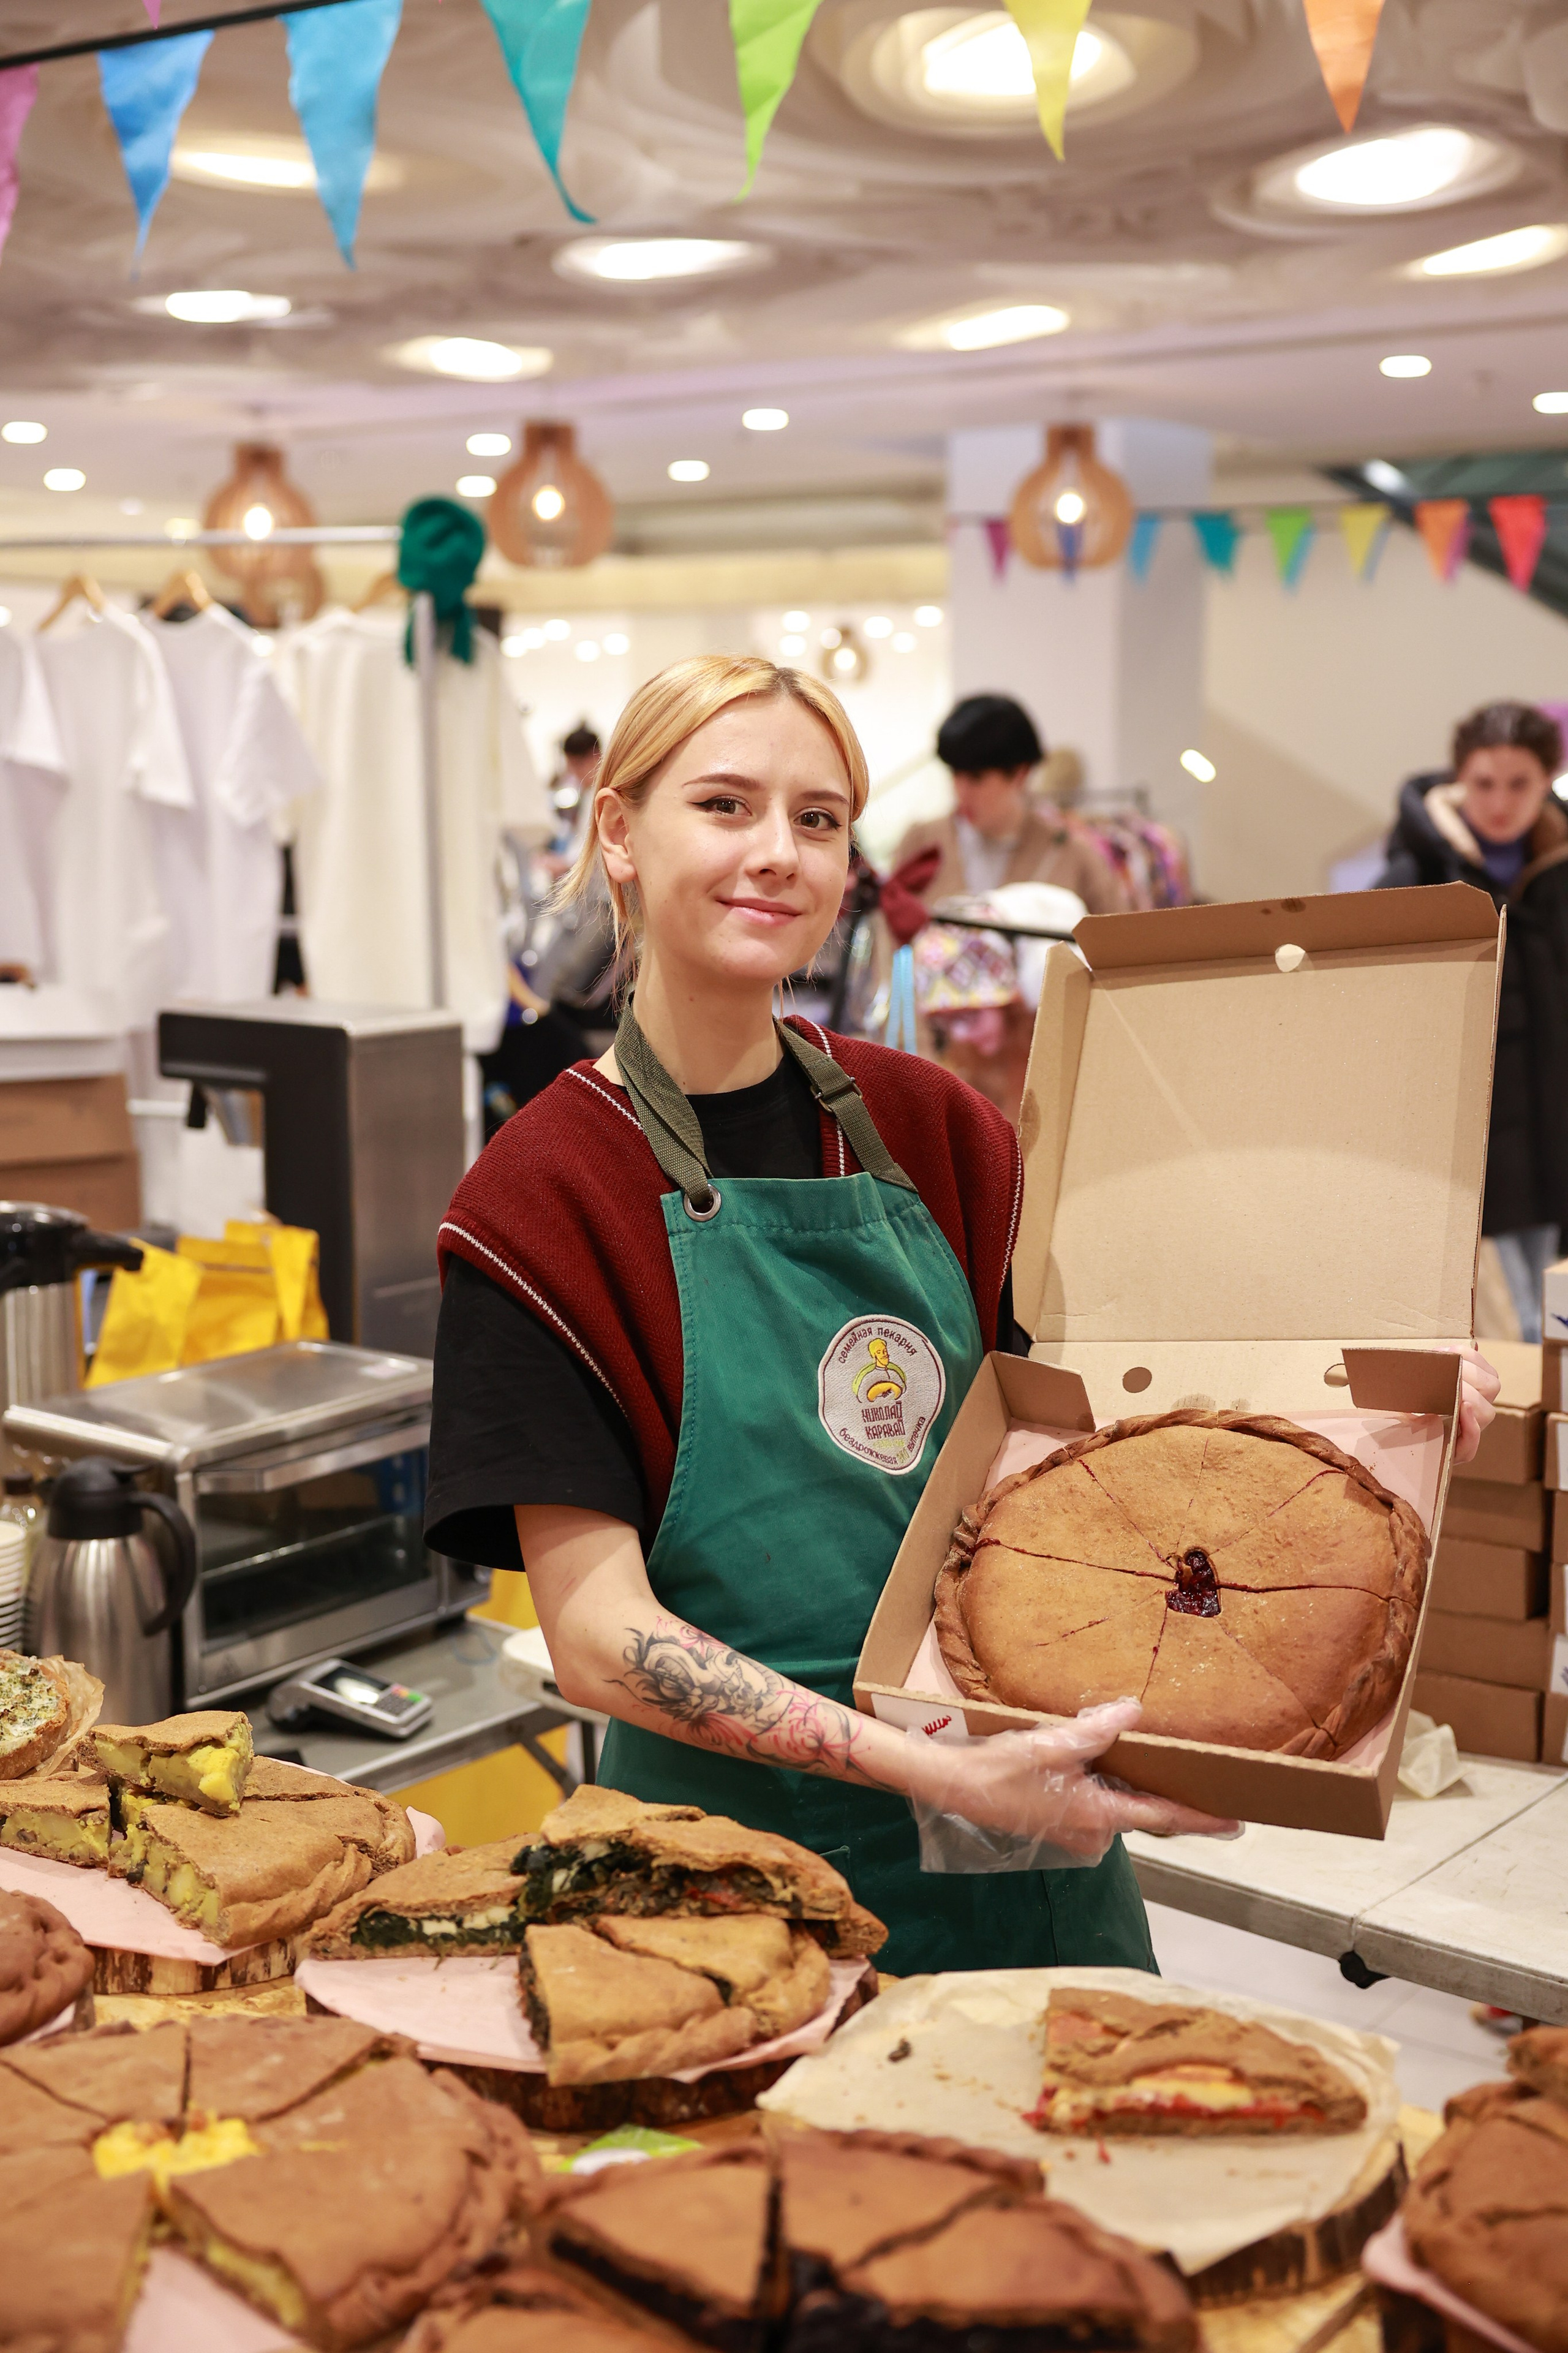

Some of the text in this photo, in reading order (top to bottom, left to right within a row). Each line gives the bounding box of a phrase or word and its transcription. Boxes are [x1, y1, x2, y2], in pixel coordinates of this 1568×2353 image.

[839, 1328, 917, 1363] семейная пекарня
[861, 1400, 903, 1422] НИКОЛАЙ
[839, 1427, 898, 1465] бездрожжевая
[907, 1416, 925, 1452] выпечка
[865, 1418, 906, 1440] КАРАВАЙ
